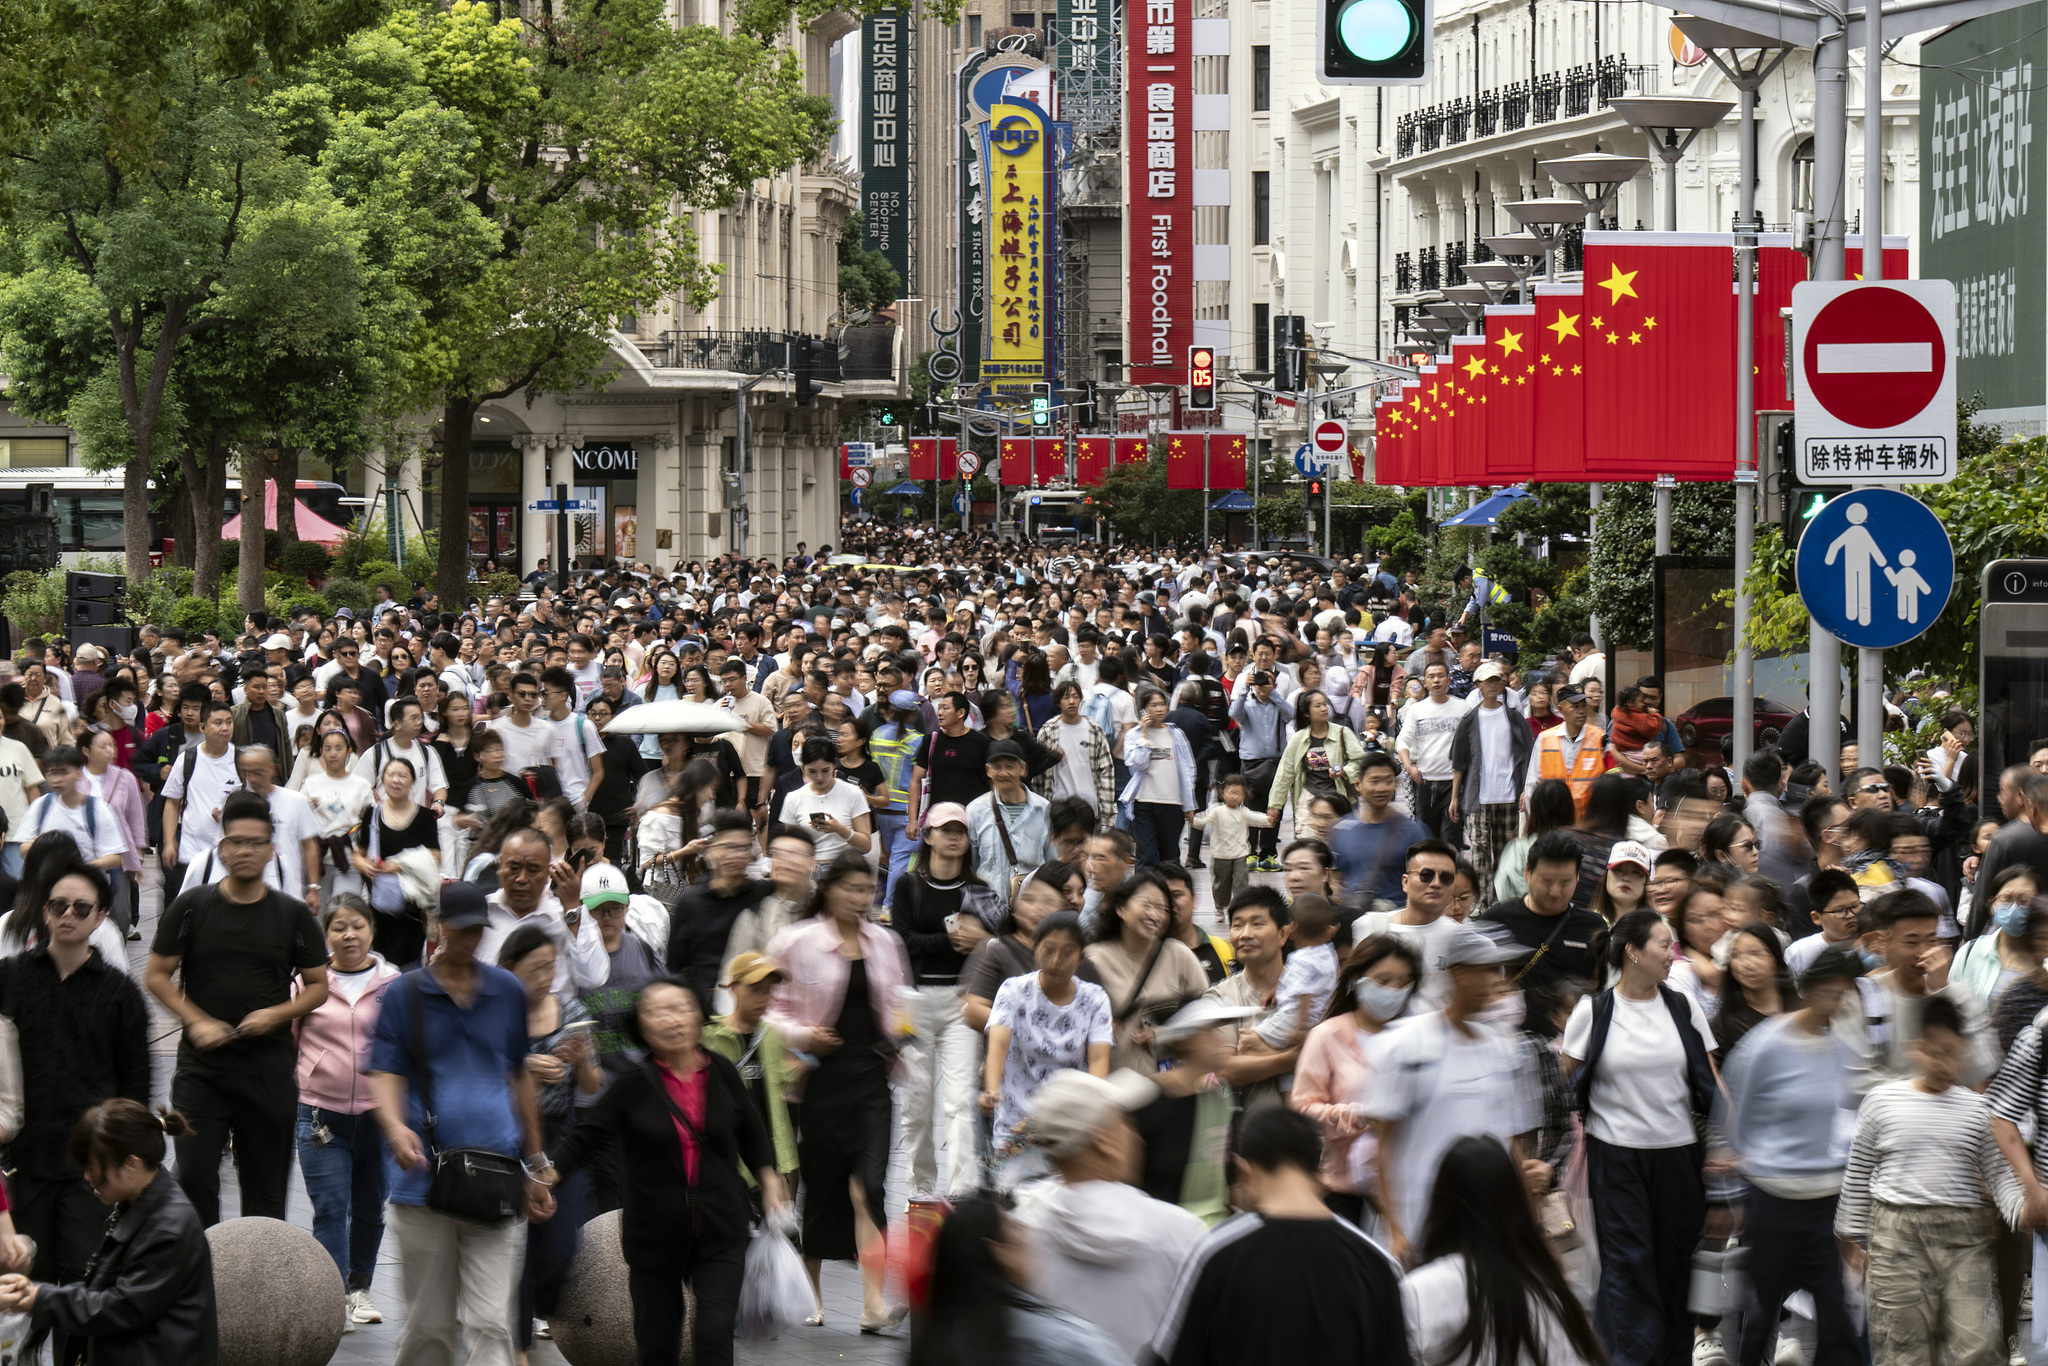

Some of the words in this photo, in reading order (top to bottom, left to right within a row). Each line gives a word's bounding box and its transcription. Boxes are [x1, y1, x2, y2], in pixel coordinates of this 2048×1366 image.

[1974, 57, 2032, 226] 让家更好
[870, 191, 879, 238] CENTER
[880, 191, 889, 251] SHOPPING
[890, 191, 900, 217] NO.1
[972, 231, 982, 266] SINCE
[1152, 215, 1172, 258] First
[1152, 265, 1173, 365] Foodhall
[1193, 369, 1212, 387] 05
[1033, 399, 1048, 411] 59
[1811, 444, 1939, 472] 除特种车辆外
